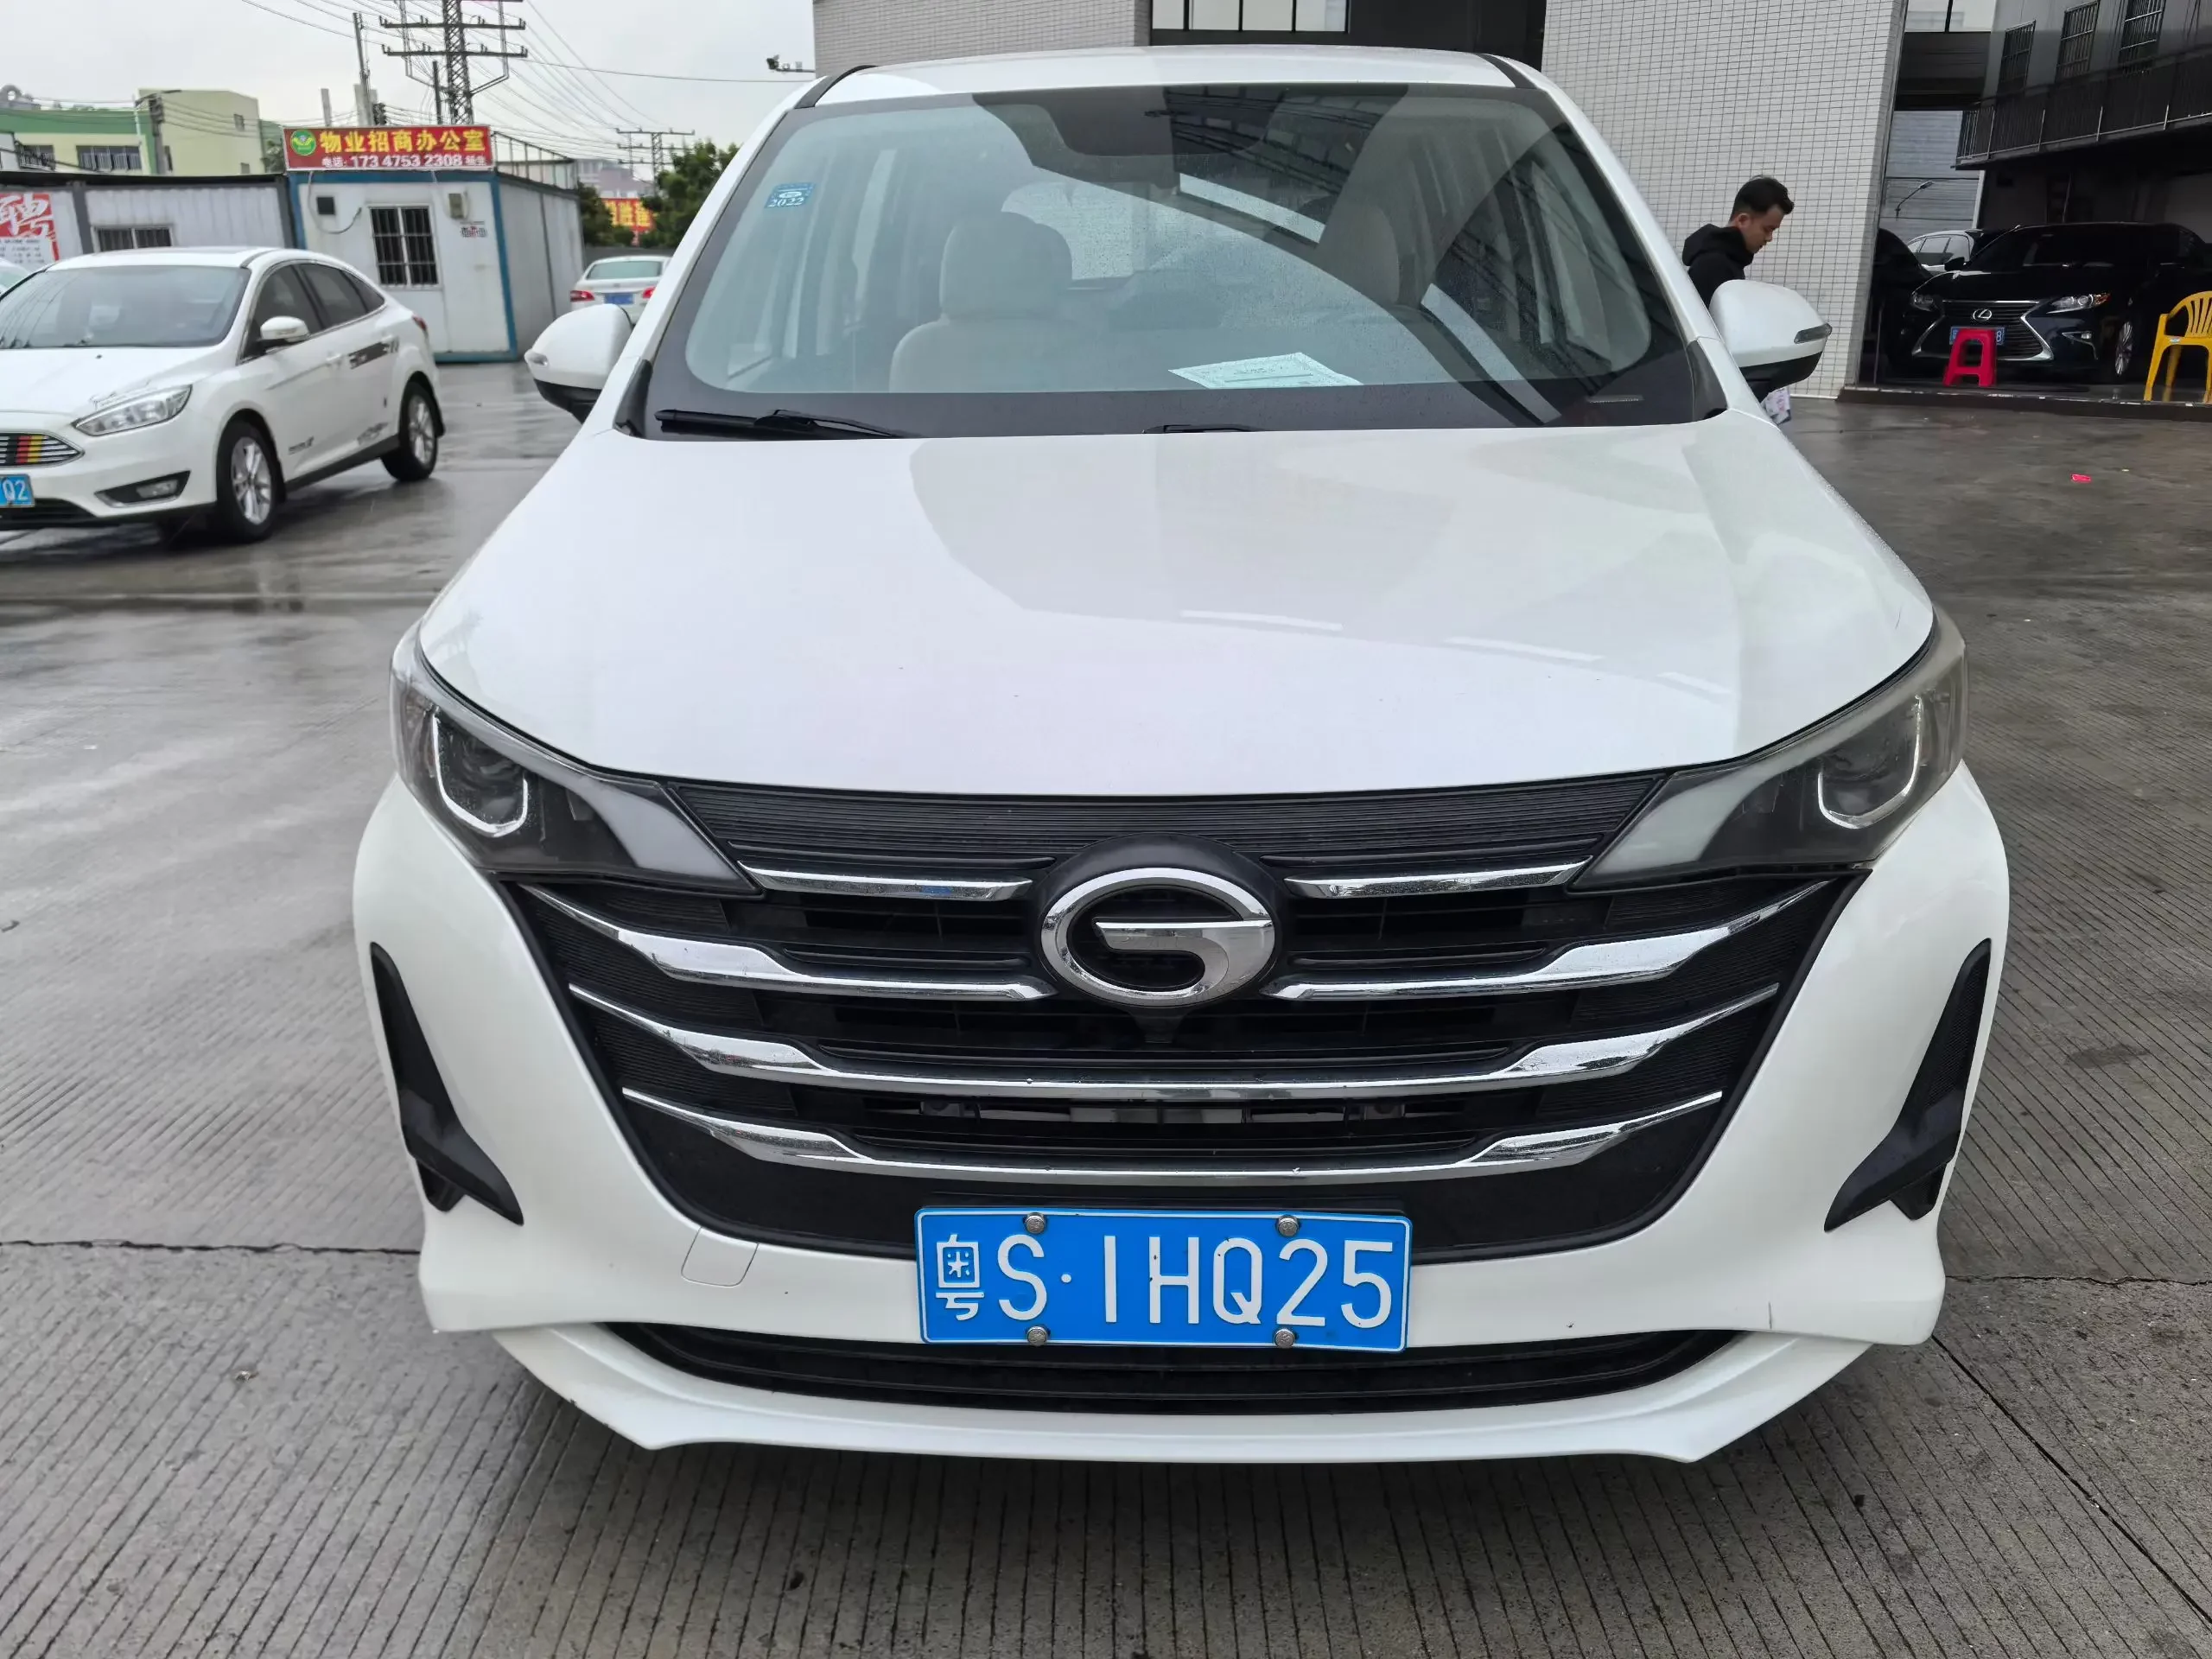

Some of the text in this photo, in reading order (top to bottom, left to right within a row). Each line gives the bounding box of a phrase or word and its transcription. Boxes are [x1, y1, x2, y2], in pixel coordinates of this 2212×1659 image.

[321, 130, 486, 154] 物业招商办公室
[350, 155, 379, 168] 173
[767, 196, 804, 207] 2022
